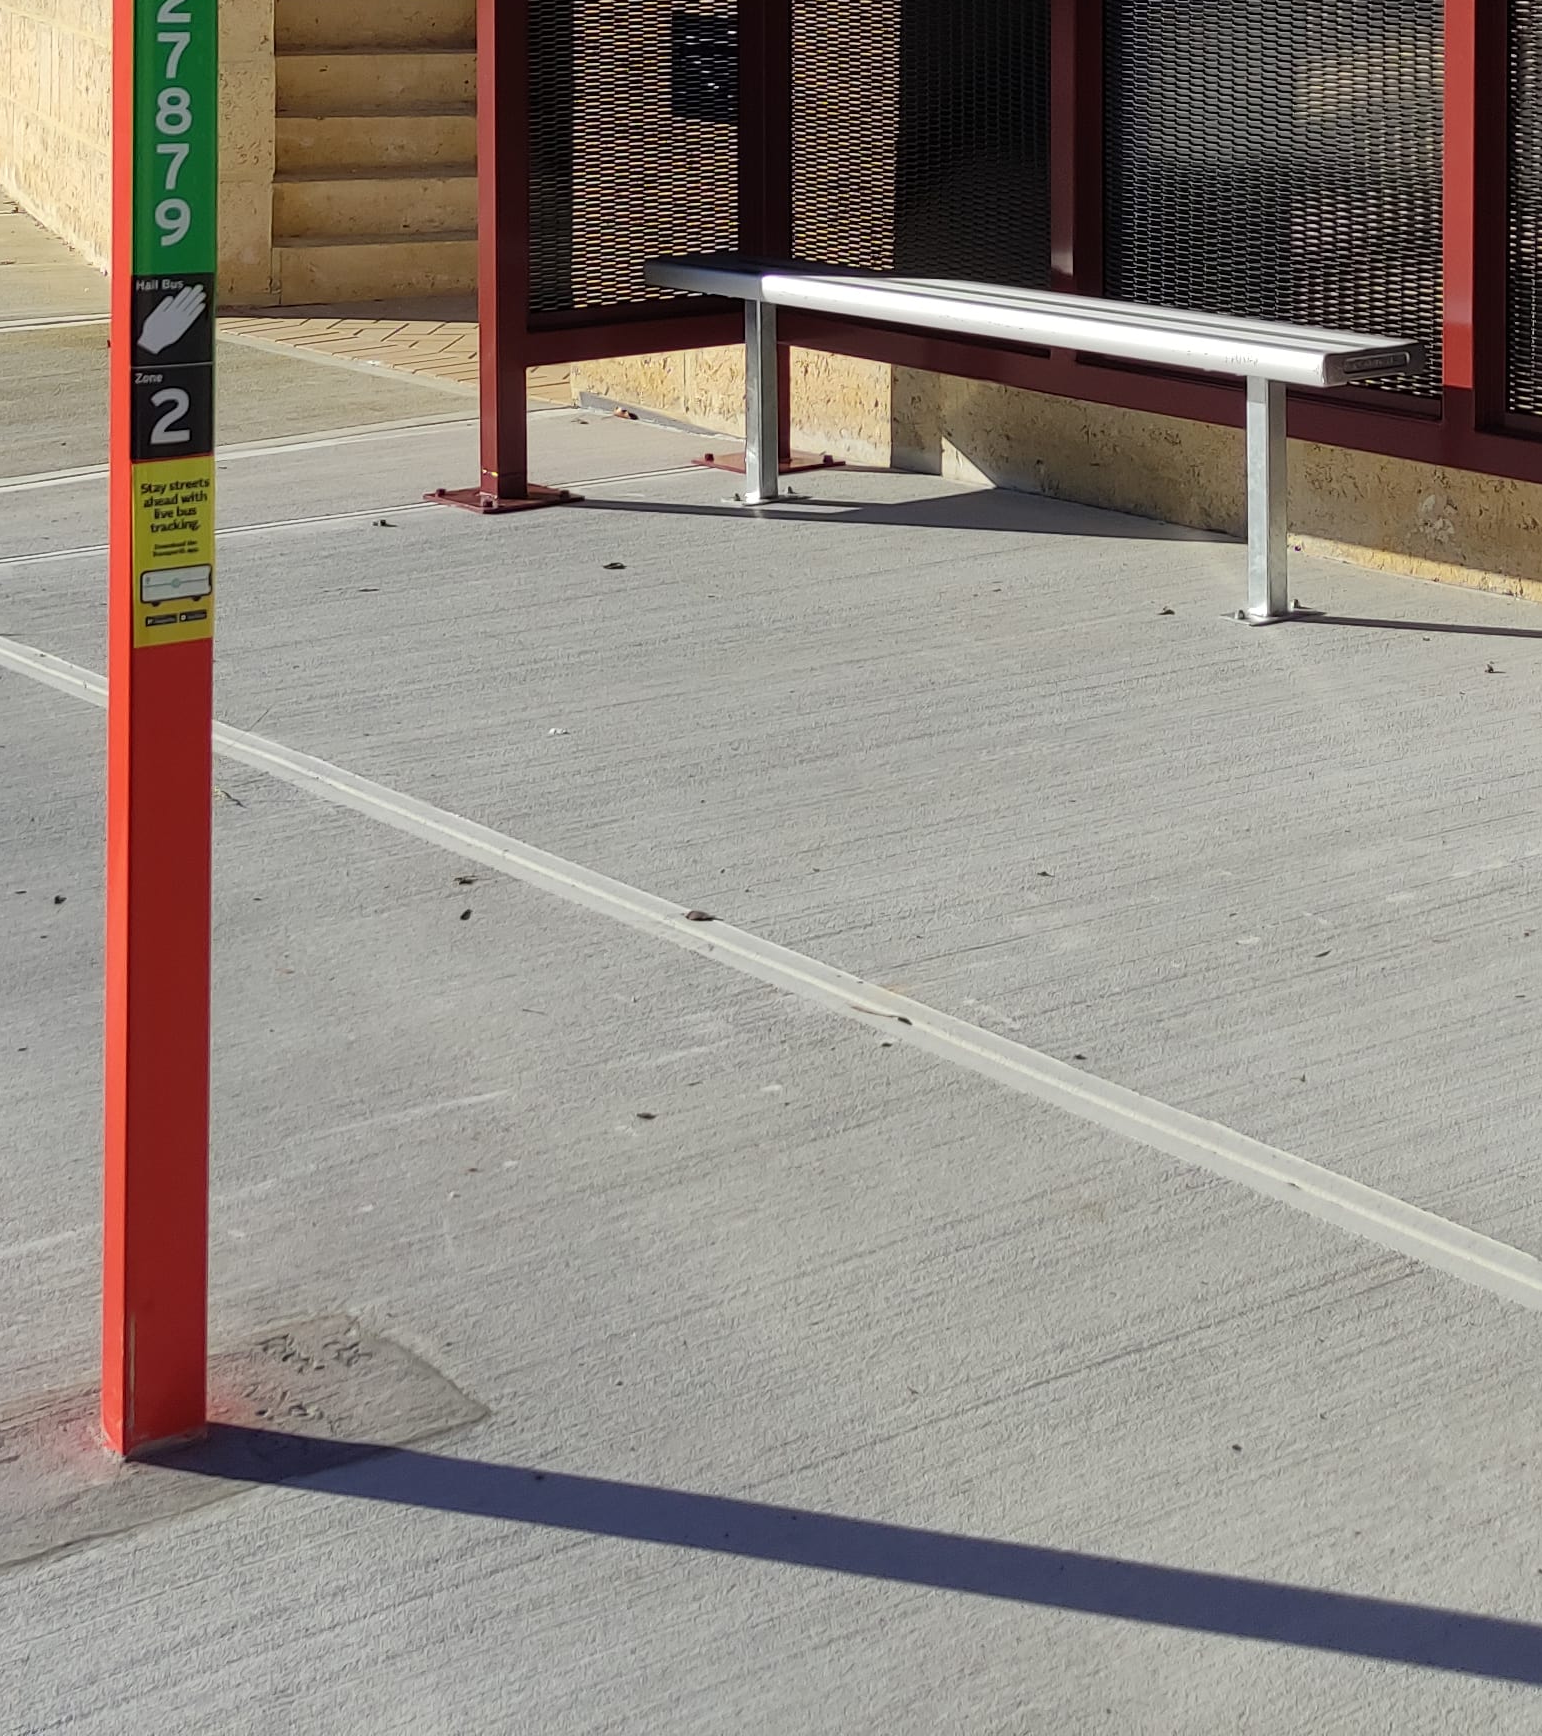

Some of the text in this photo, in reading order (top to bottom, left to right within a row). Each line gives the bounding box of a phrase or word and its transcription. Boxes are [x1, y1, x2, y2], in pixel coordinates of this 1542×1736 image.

[136, 278, 184, 290] Hail Bus
[134, 372, 163, 384] Zone
[150, 387, 191, 445] 2
[140, 478, 210, 495] Stay streets
[144, 490, 208, 508] ahead with
[154, 506, 197, 519] live bus
